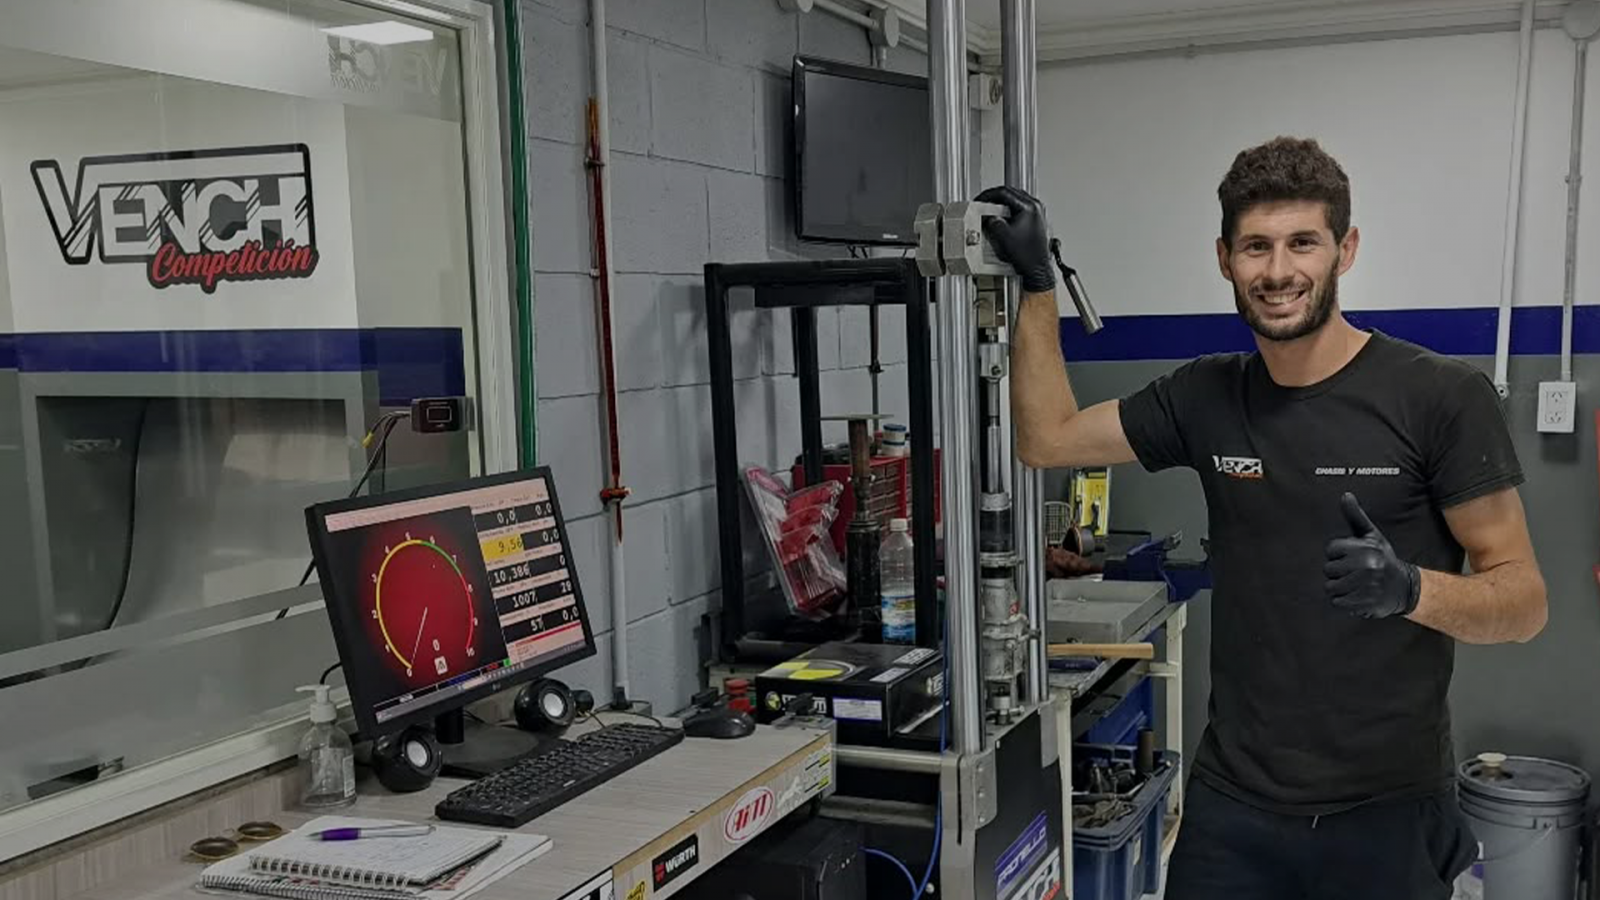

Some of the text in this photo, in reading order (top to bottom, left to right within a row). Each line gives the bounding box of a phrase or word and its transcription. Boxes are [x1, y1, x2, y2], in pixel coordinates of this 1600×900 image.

[30, 143, 315, 265] VENCH
[150, 239, 315, 291] Competición
[1355, 467, 1400, 475] MOTORES
